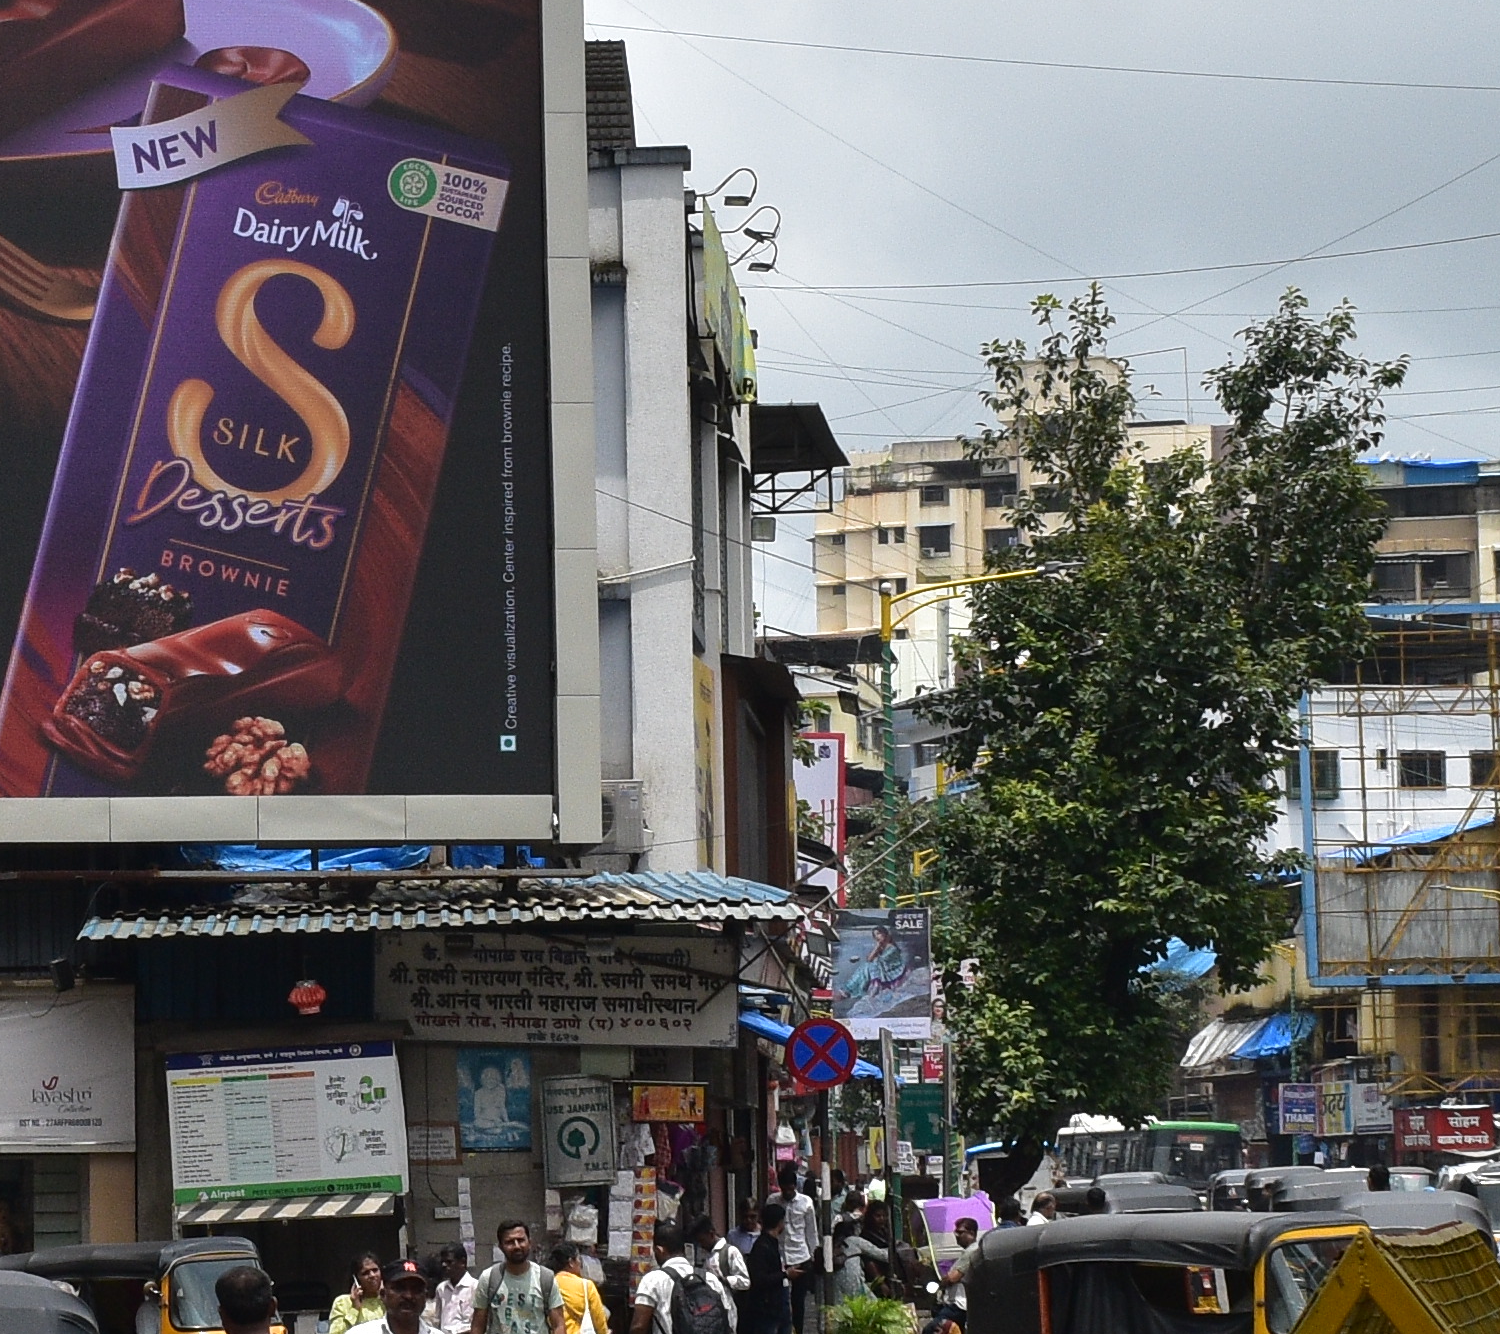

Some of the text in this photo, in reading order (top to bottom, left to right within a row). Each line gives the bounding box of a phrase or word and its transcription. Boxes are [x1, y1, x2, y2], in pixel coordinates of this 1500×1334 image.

[132, 120, 217, 174] NEW
[254, 180, 319, 206] Cadbury
[443, 172, 487, 195] 100%
[439, 193, 484, 211] SOURCED
[233, 207, 310, 253] Dairy
[212, 417, 300, 464] SILK
[127, 459, 346, 549] Desserts
[501, 342, 517, 730] Creative visualization. Center inspired from brownie recipe.
[160, 549, 290, 598] BROWNIE
[895, 920, 924, 930] SALE
[416, 963, 458, 986] लक्ष्मी
[461, 969, 523, 987] नारायण
[601, 968, 646, 991] स्वामी
[436, 988, 481, 1011] आनंद
[485, 988, 534, 1012] भारती
[538, 994, 599, 1014] महाराज
[602, 991, 698, 1015] समाधीस्थान
[415, 1013, 461, 1028] गोखले
[501, 1012, 547, 1029] नौपाडा
[552, 1014, 582, 1030] ठाणे
[588, 1016, 614, 1031] (प)
[619, 1017, 693, 1032] ४००६०२
[31, 1087, 92, 1106] Jayashri
[546, 1101, 608, 1115] USE JANPATH
[1446, 1111, 1480, 1129] सोहम
[210, 1189, 246, 1200] Airpest
